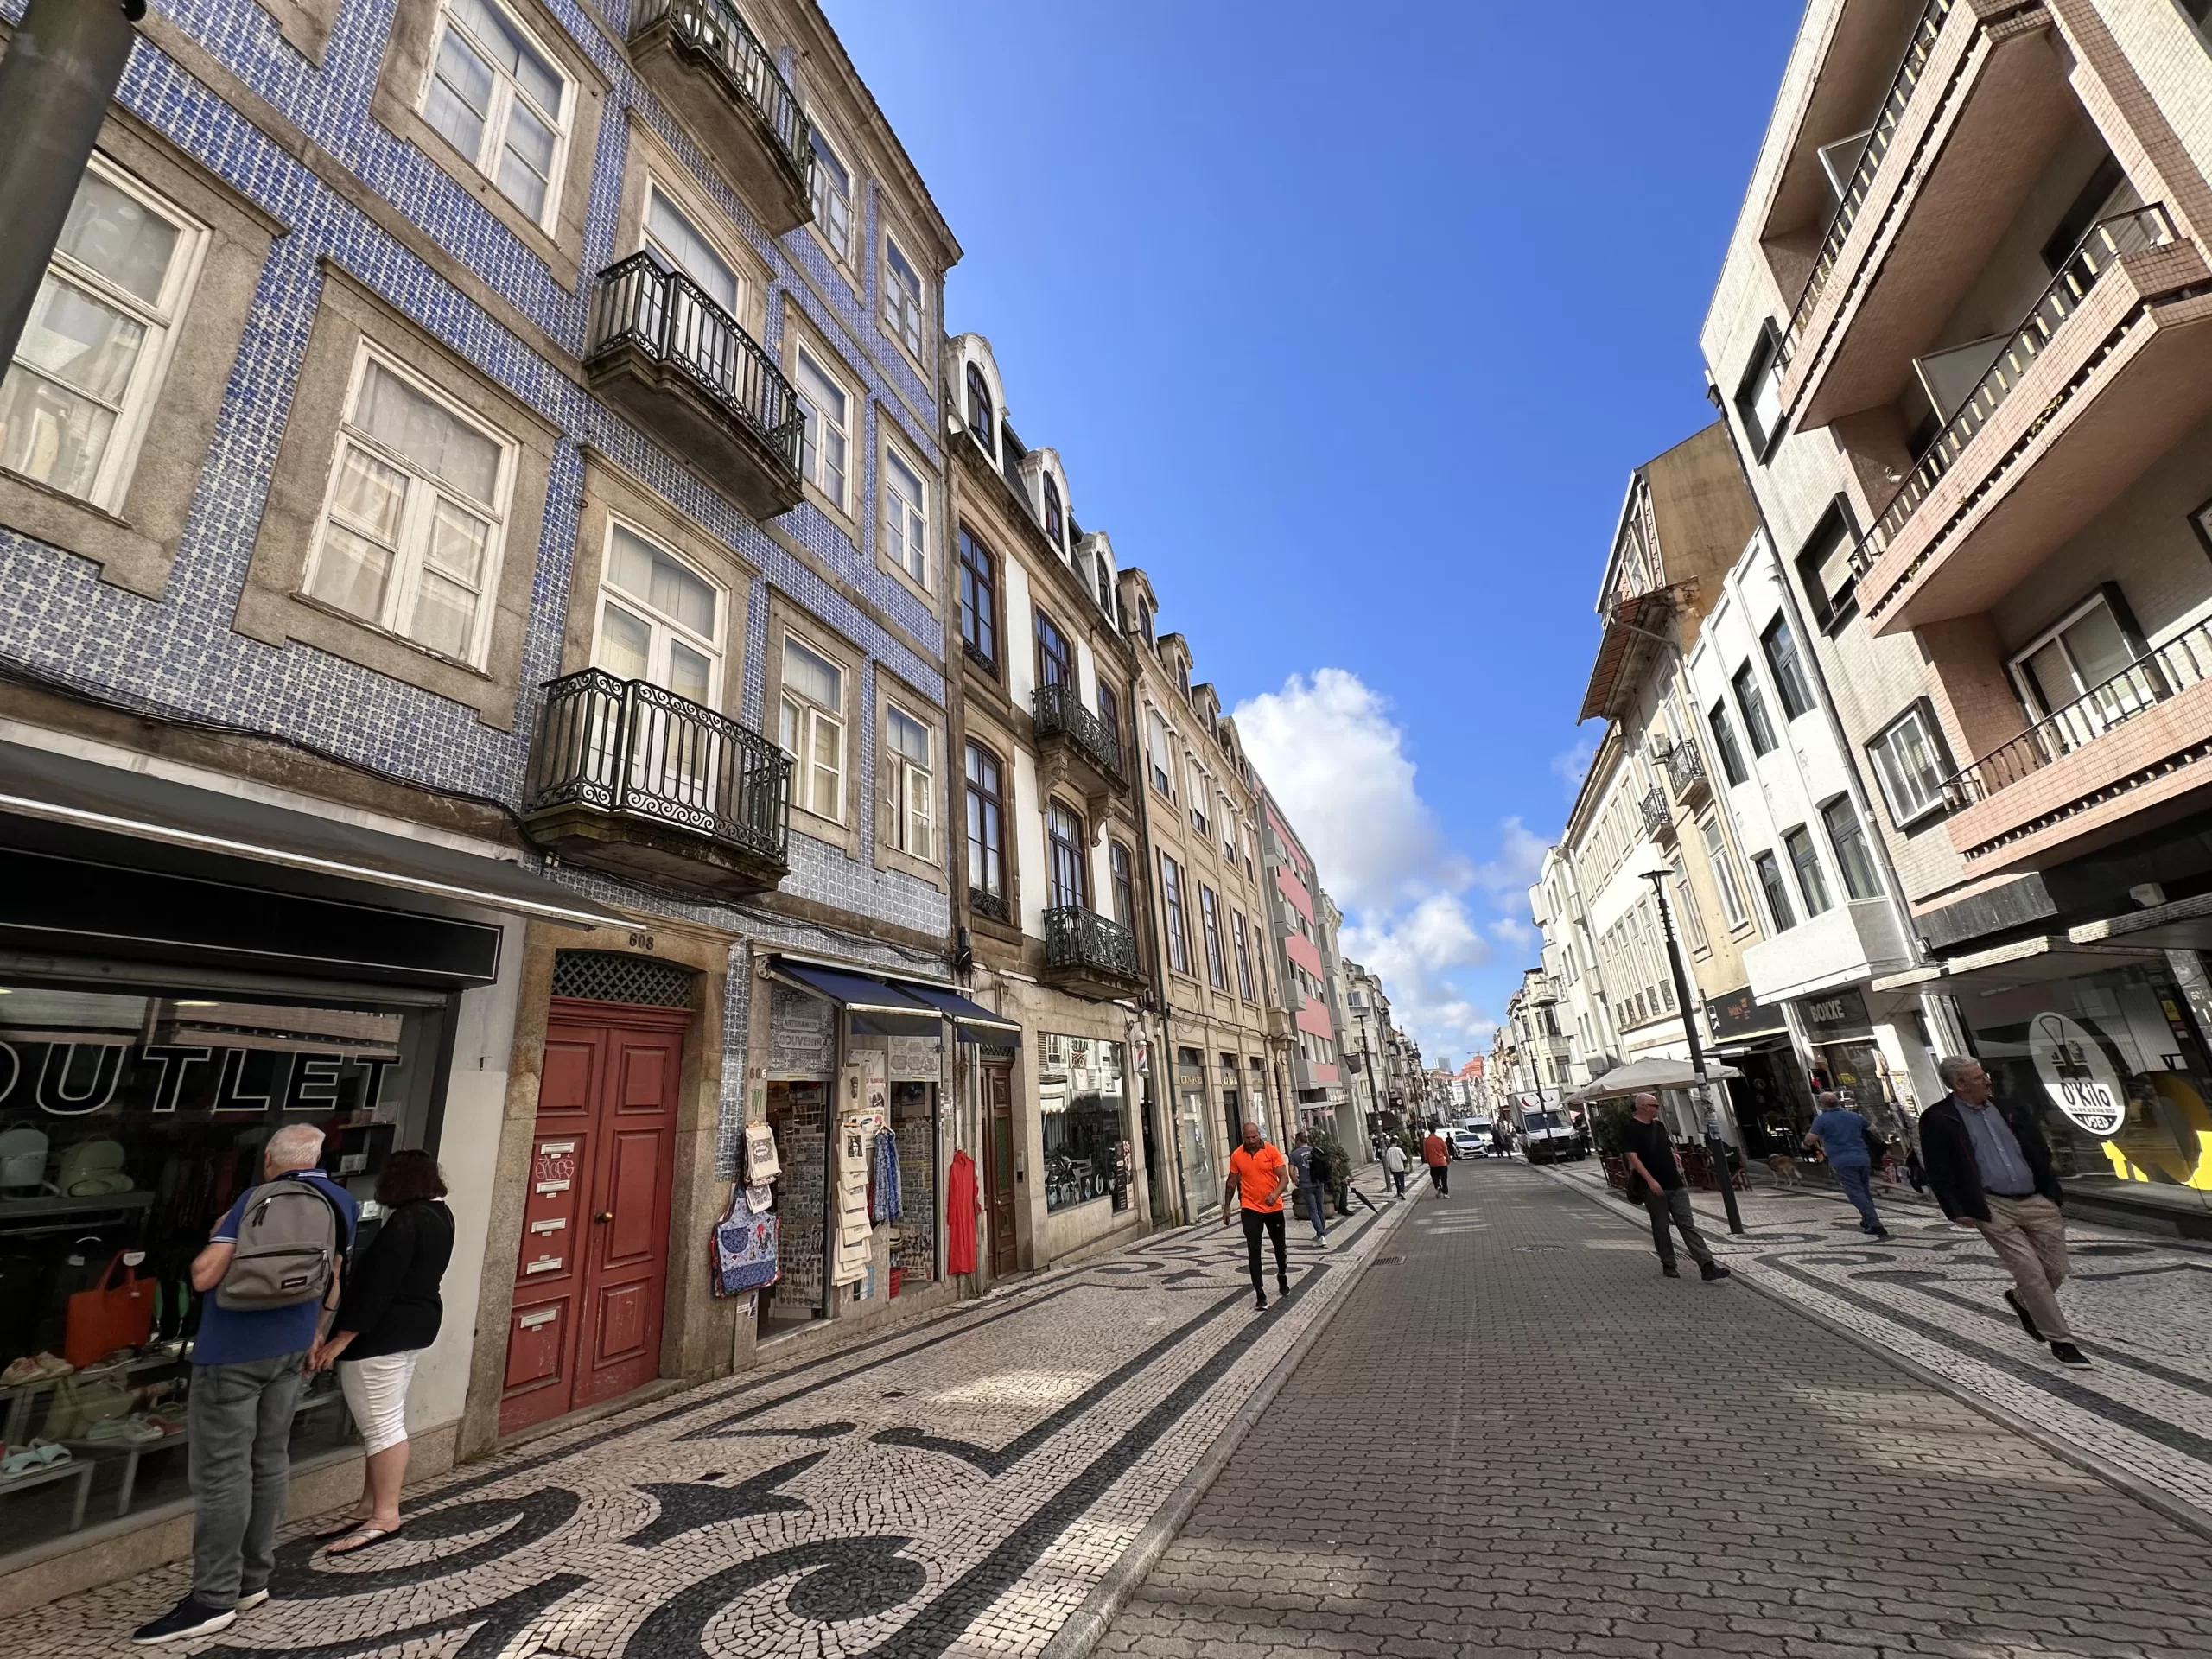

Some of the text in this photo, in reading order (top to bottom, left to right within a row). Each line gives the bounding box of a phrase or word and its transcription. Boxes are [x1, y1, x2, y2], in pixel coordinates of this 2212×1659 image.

[629, 932, 654, 950] 608
[1809, 999, 1846, 1023] BOXXE
[779, 1034, 822, 1047] SOUVENIR
[0, 1041, 402, 1115] UTLET
[749, 1067, 767, 1079] 606
[2060, 1081, 2111, 1107] O'Kilo
[2082, 1115, 2109, 1128] USED
